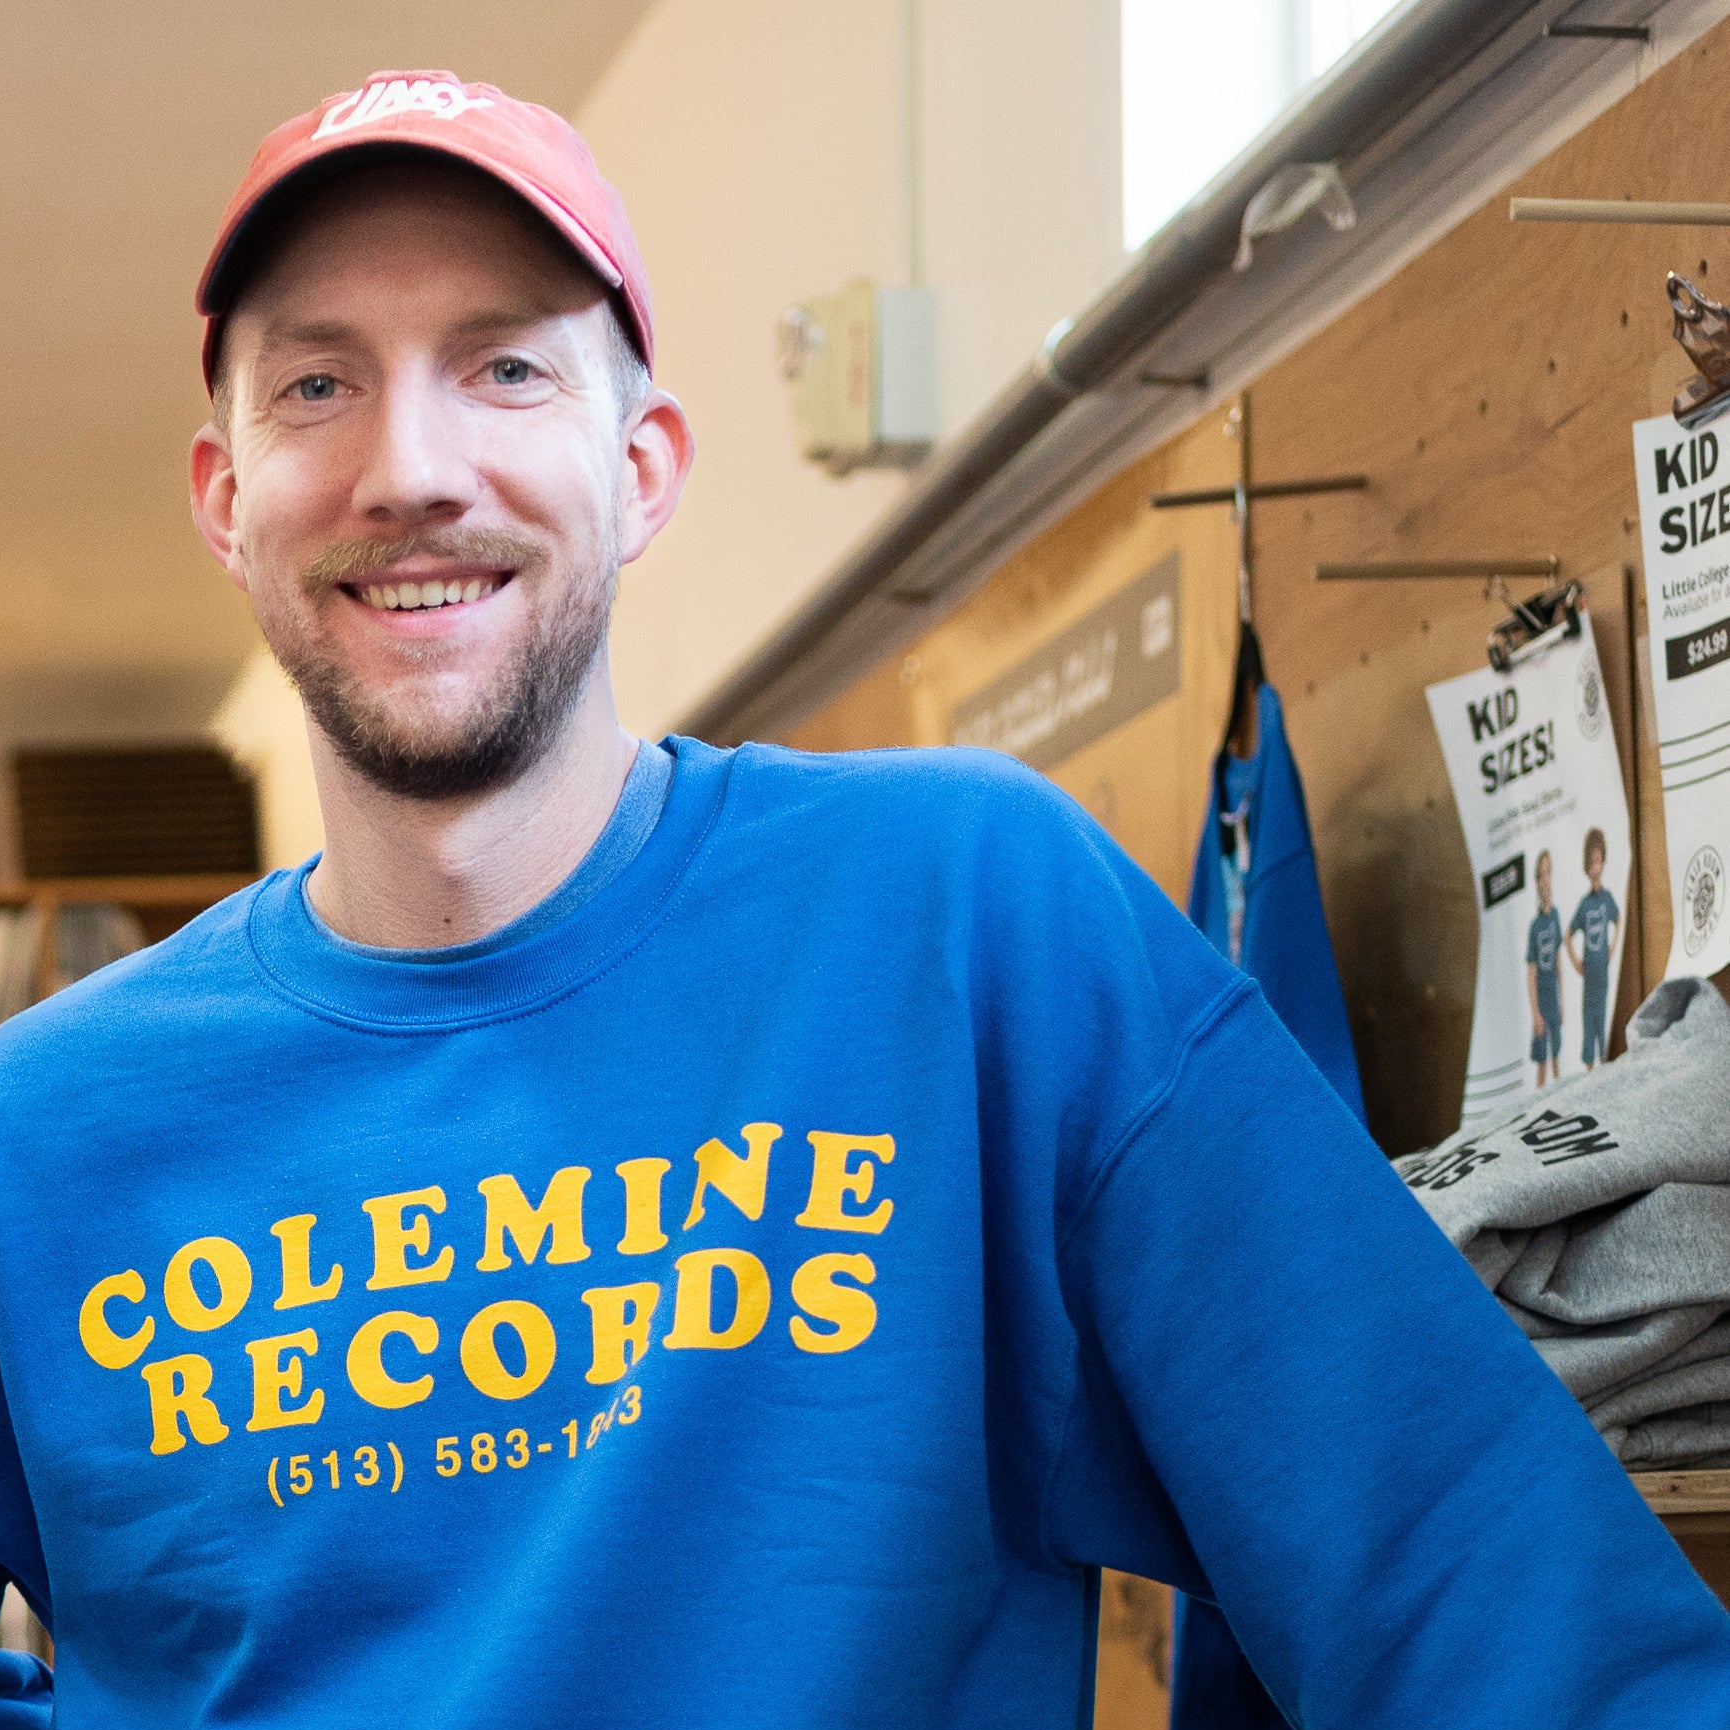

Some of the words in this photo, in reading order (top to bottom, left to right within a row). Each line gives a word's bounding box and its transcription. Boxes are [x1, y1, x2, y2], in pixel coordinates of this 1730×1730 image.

[1654, 431, 1719, 495] KID
[1467, 686, 1519, 742] KID
[1480, 718, 1556, 795] SIZES!
[78, 1122, 897, 1370] COLEMINE
[140, 1247, 878, 1457] RECORDS
[266, 1441, 406, 1508] (513)
